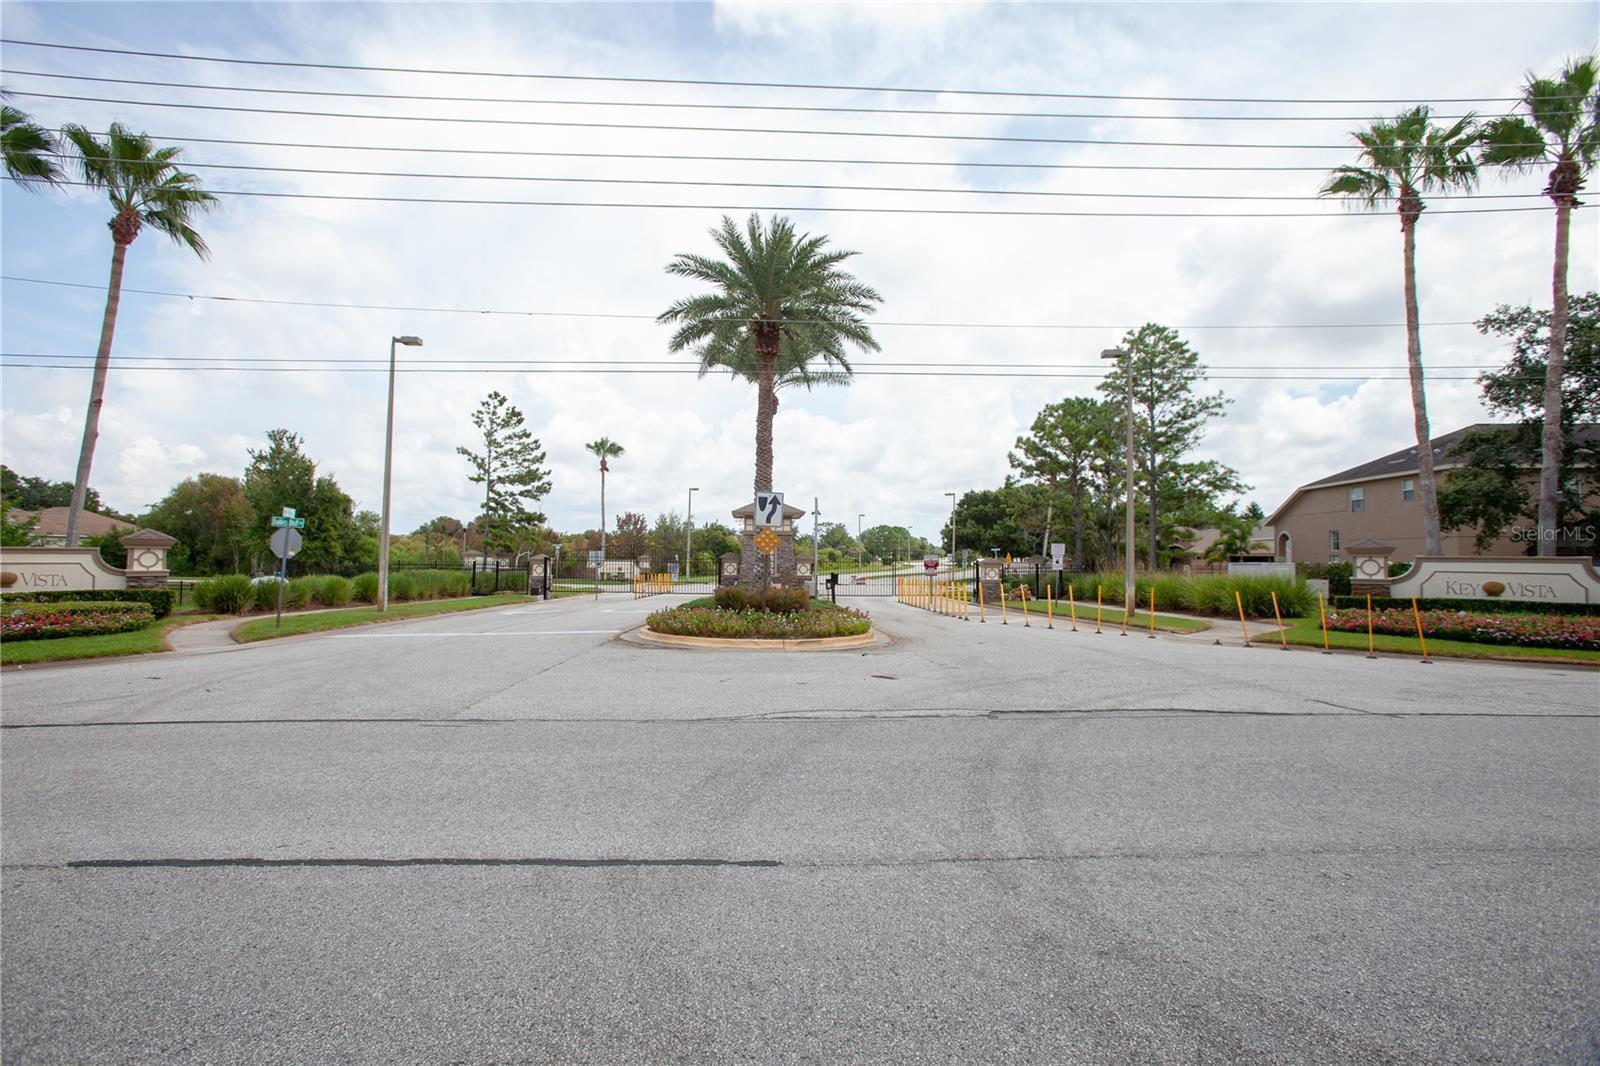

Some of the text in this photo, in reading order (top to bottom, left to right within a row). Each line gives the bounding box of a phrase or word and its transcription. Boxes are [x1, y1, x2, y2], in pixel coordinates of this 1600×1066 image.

[19, 572, 68, 587] VISTA
[1446, 581, 1558, 598] KEY VISTA
